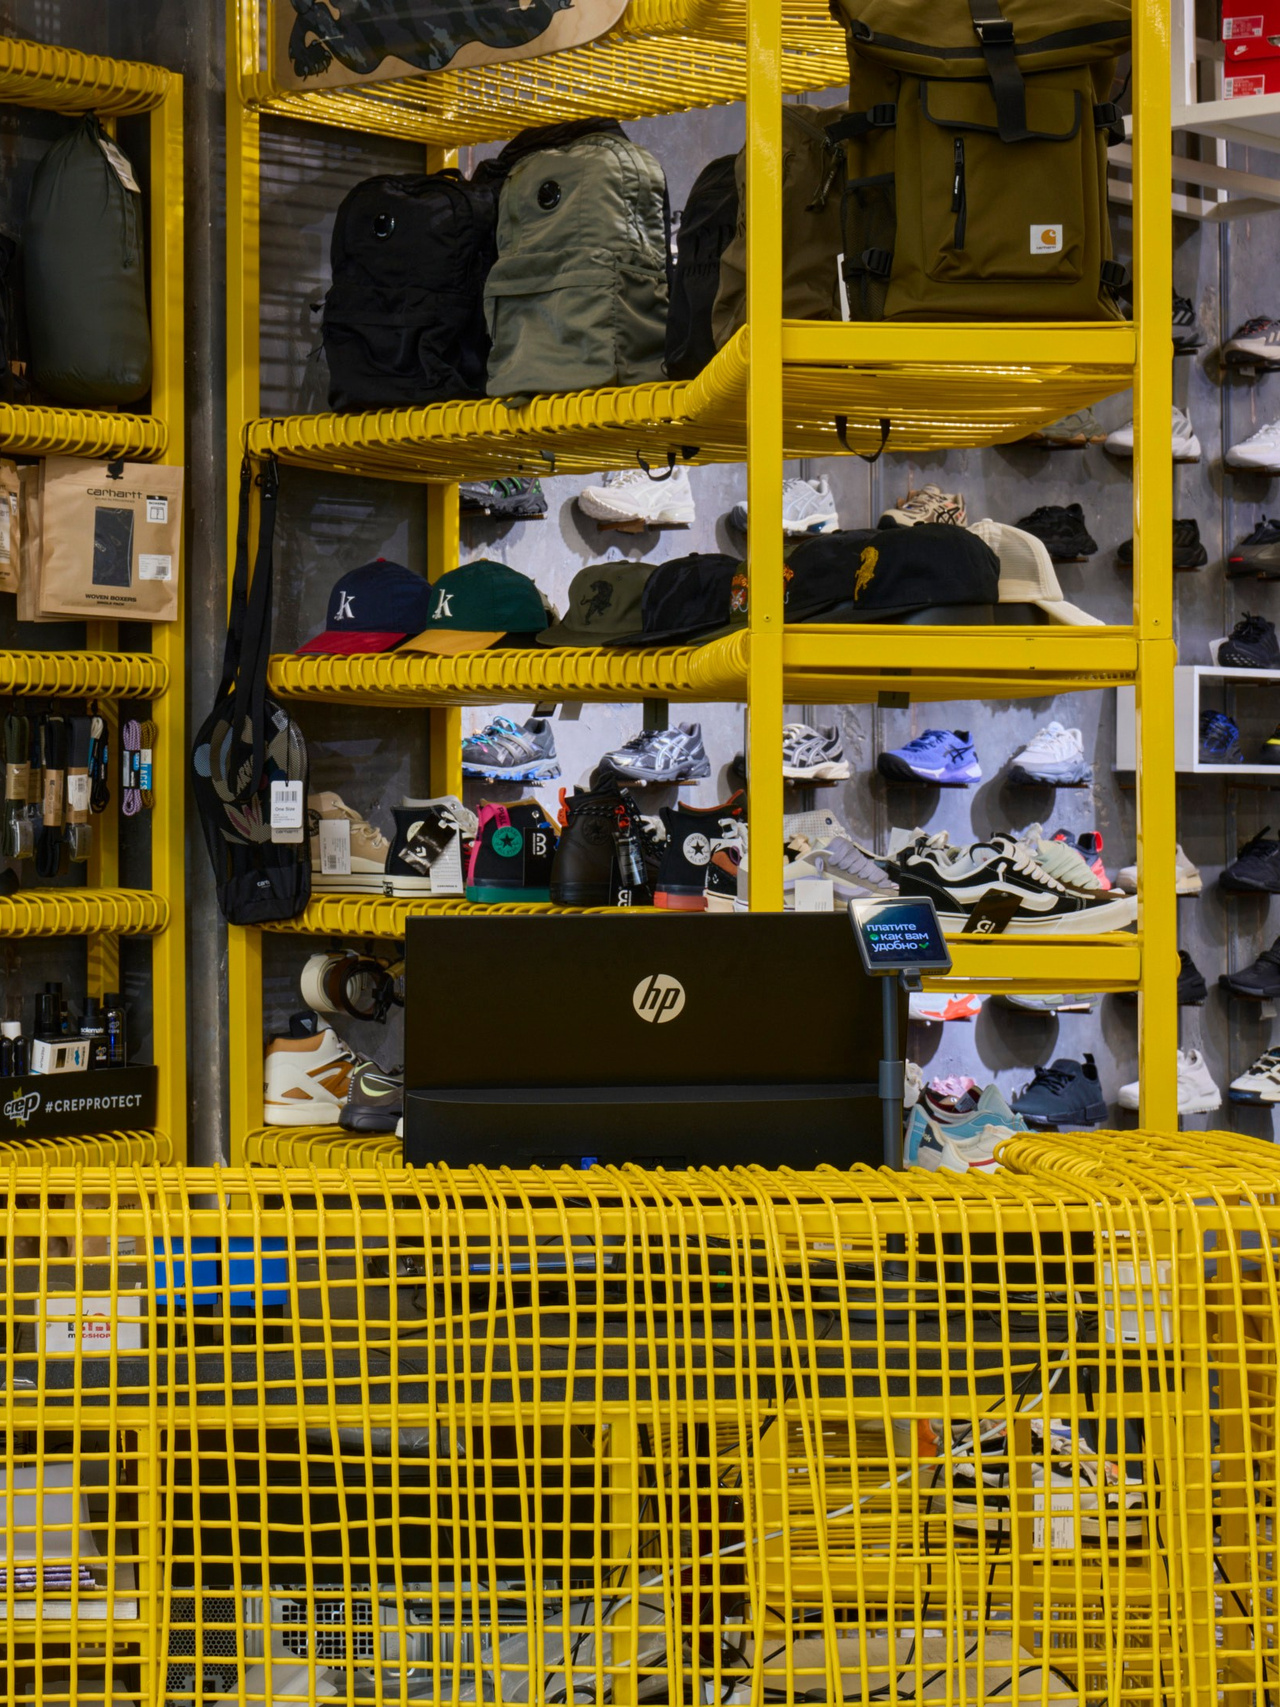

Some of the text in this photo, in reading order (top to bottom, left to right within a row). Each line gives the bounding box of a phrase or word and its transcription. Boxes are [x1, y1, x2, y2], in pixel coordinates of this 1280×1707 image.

[86, 487, 142, 499] carhartt
[497, 807, 507, 826] PULL
[866, 922, 917, 932] платите
[880, 931, 929, 941] как вам
[871, 940, 918, 953] удобно
[636, 974, 683, 1023] hp
[4, 1092, 41, 1120] crep
[45, 1094, 142, 1113] #CREPPROTECT
